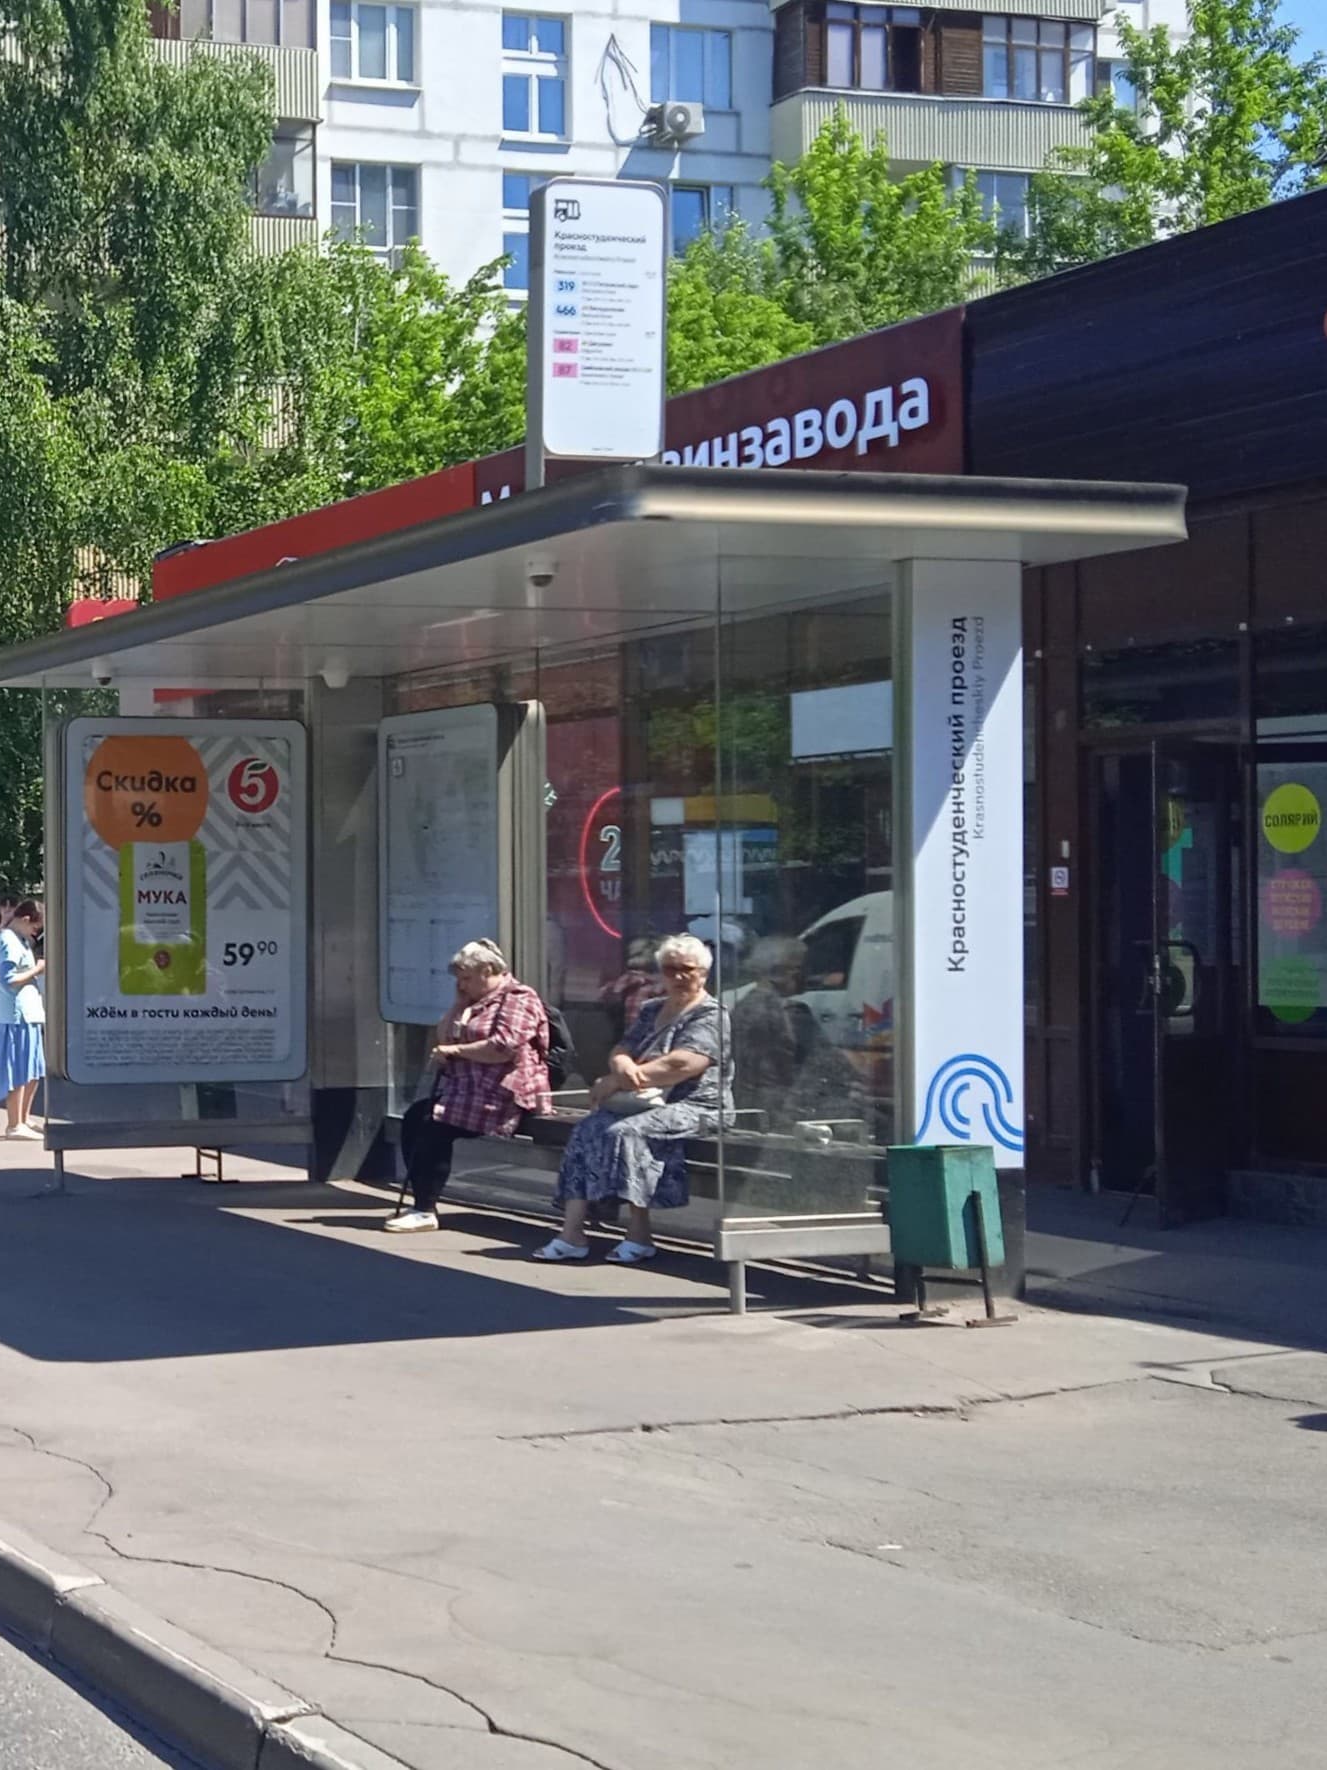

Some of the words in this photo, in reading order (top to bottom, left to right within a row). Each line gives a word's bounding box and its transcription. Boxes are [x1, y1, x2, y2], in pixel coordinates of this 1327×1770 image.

[558, 280, 576, 291] 319
[556, 305, 577, 316] 466
[951, 616, 969, 705] проезд
[96, 769, 198, 793] Скидка
[131, 801, 163, 828] %
[1264, 810, 1319, 828] СОЛЯРИЙ
[947, 713, 970, 973] Красностуденческий
[137, 890, 188, 905] МУКА
[86, 1006, 128, 1019] Ждём
[130, 1009, 139, 1019] в
[142, 1009, 178, 1019] гости
[183, 1006, 238, 1019] каждый
[241, 1006, 278, 1019] день!
